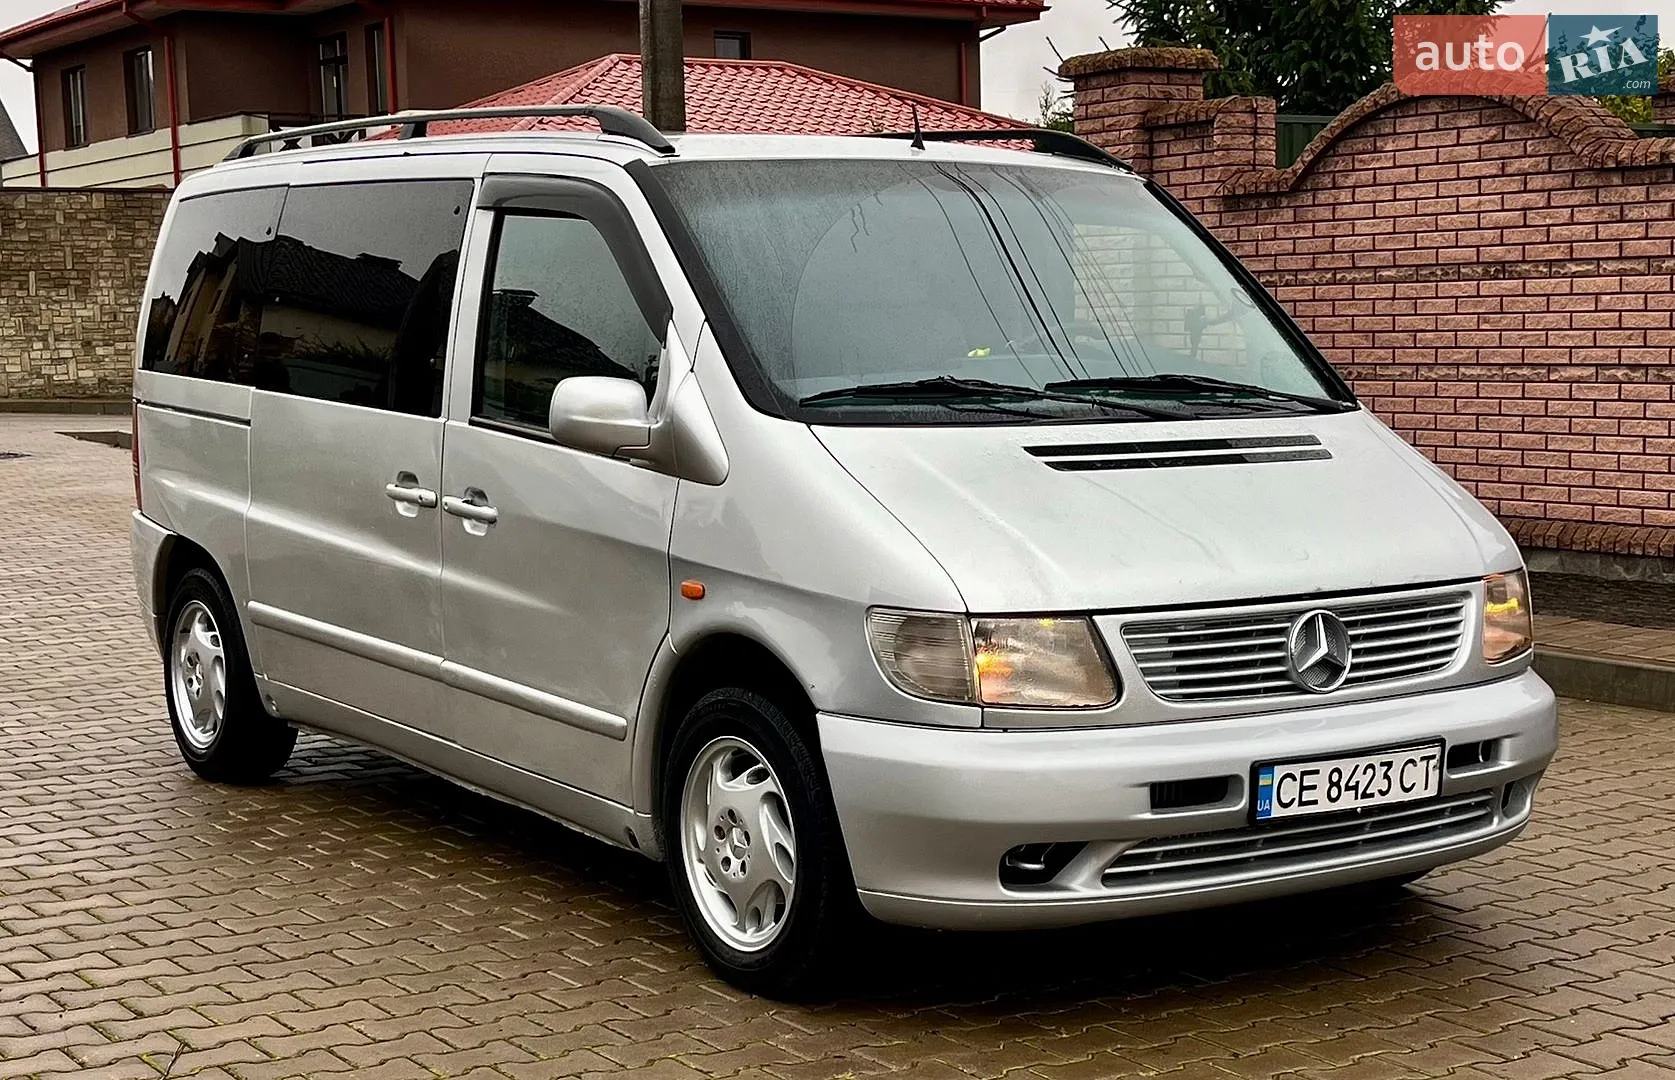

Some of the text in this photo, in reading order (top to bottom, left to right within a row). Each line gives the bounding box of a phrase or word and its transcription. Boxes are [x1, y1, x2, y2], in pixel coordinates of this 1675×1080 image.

[1276, 754, 1437, 808] CE 8423 CT
[1257, 799, 1271, 812] UA
